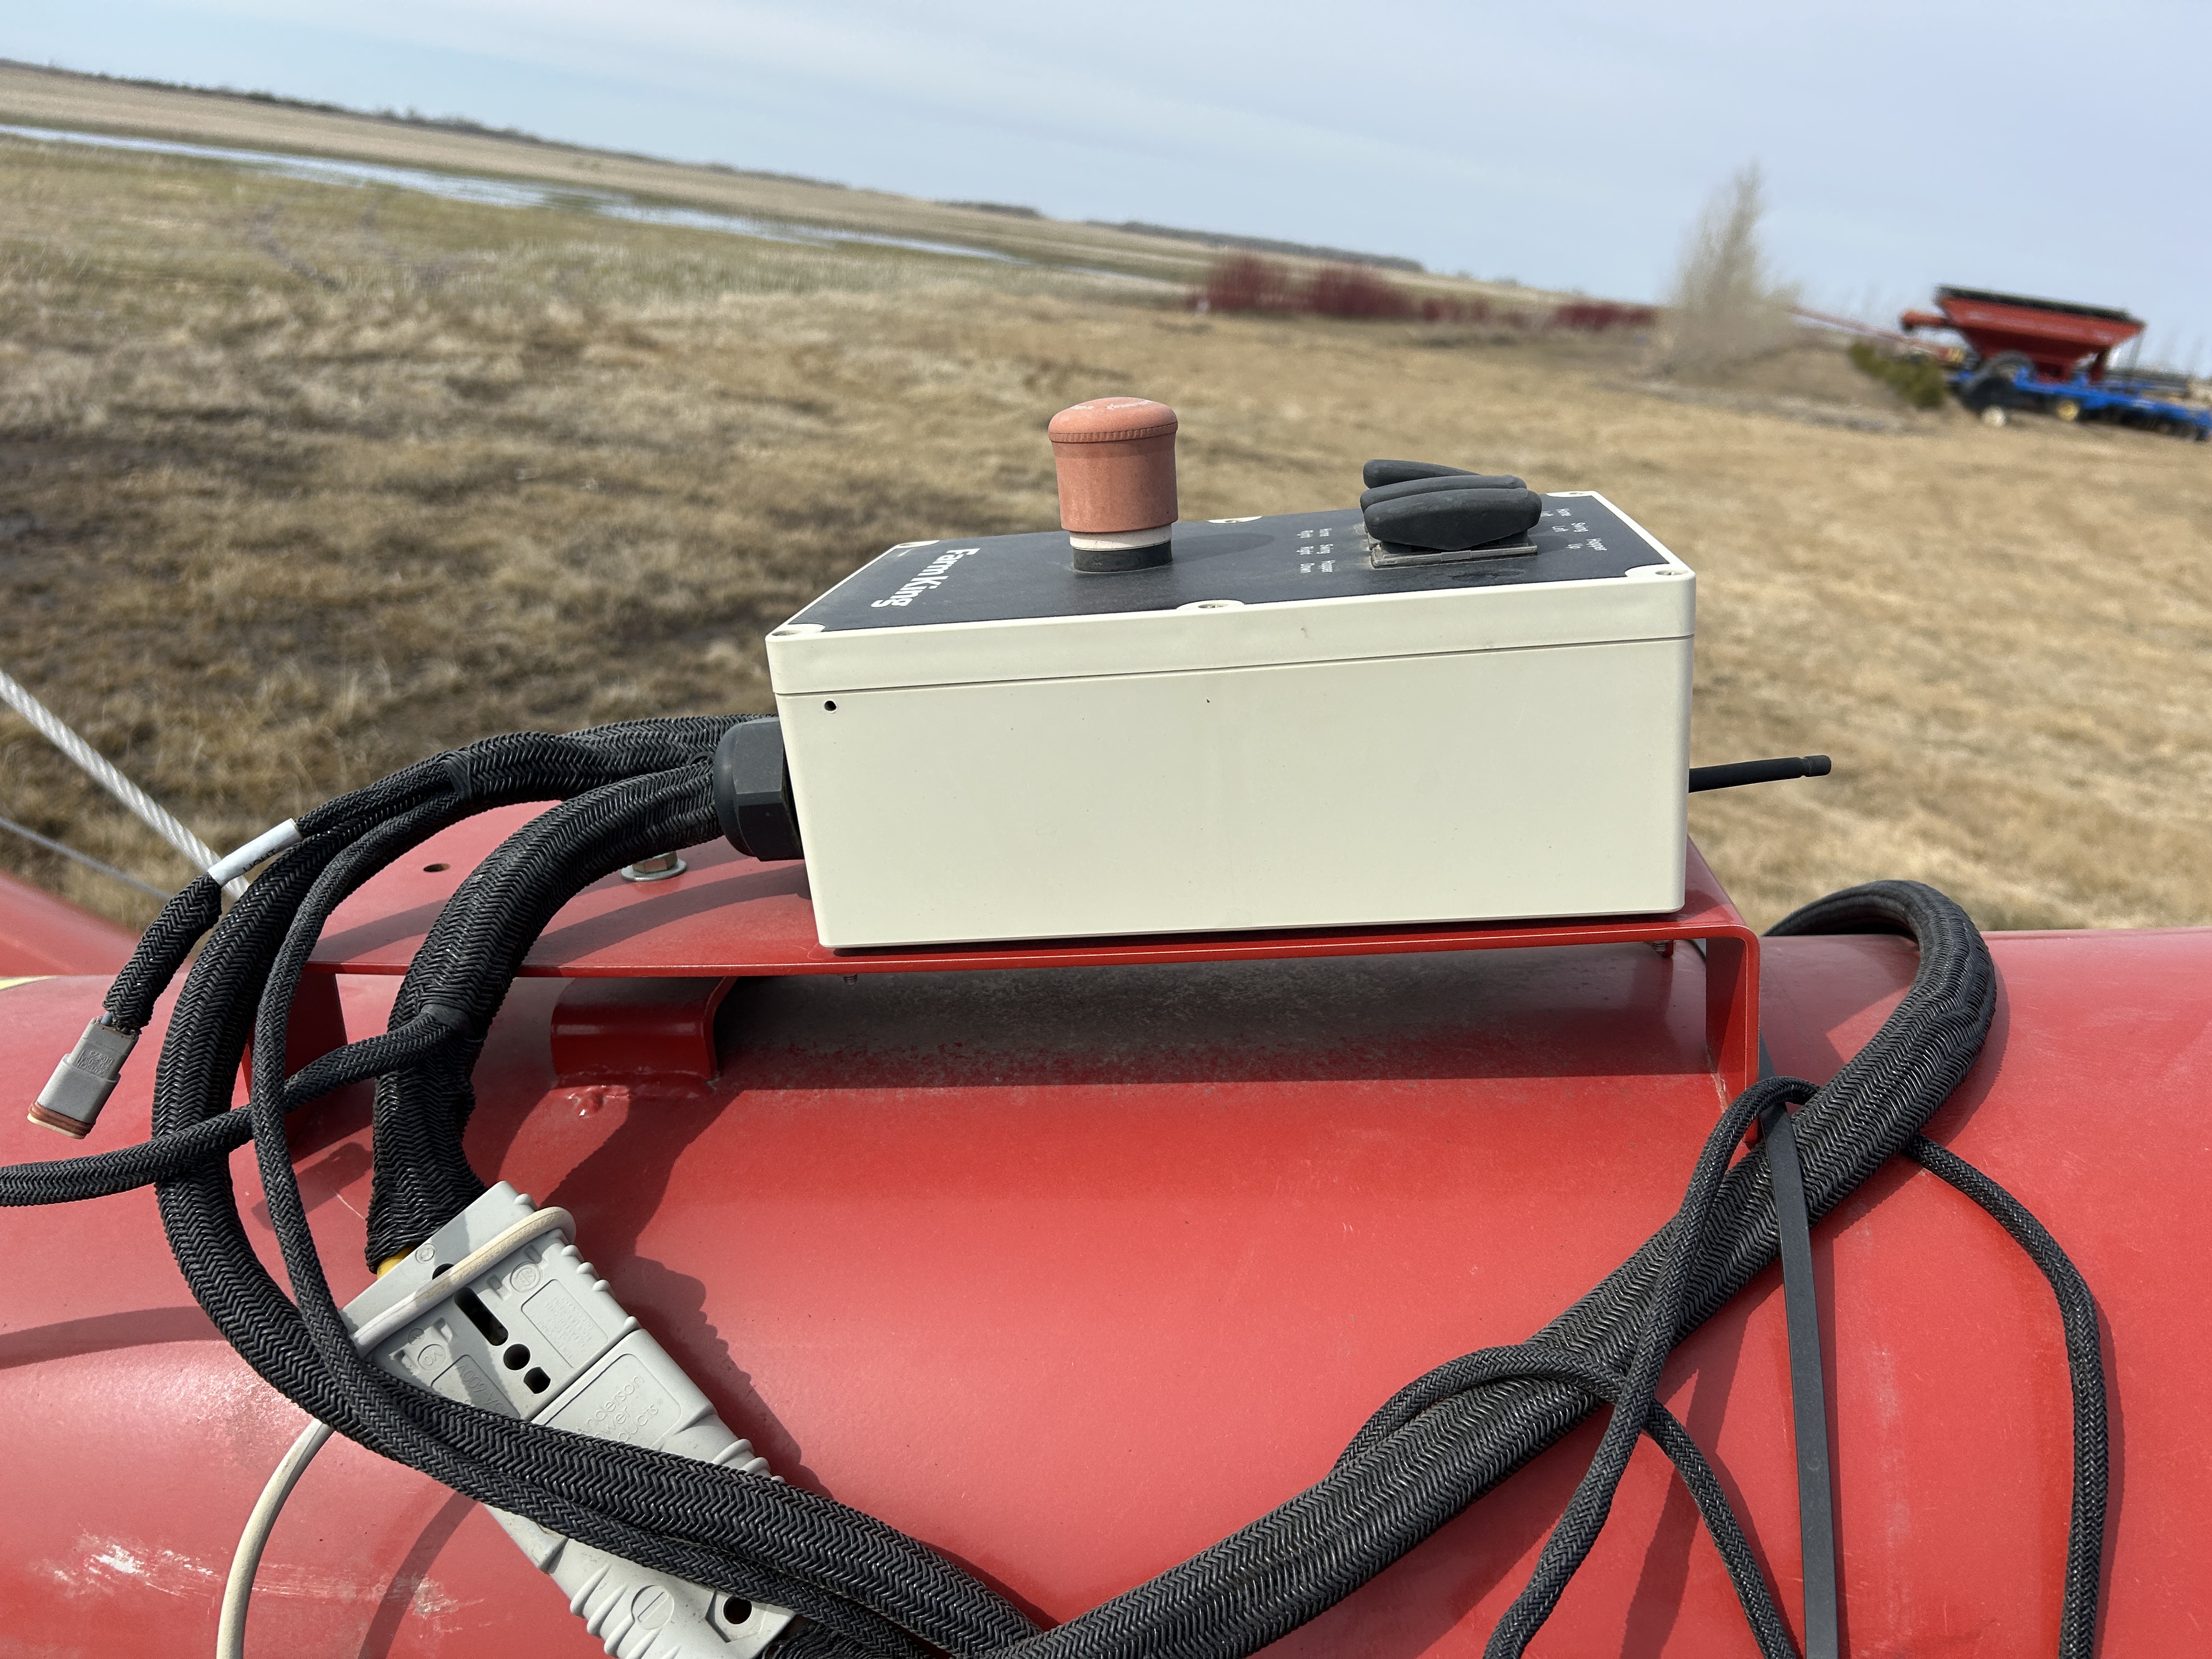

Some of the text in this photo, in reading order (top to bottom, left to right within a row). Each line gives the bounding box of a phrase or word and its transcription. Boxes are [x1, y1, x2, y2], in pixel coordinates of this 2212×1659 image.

[1571, 522, 1590, 532] Swing
[1586, 538, 1607, 551] Hopper
[1300, 563, 1315, 573] Down
